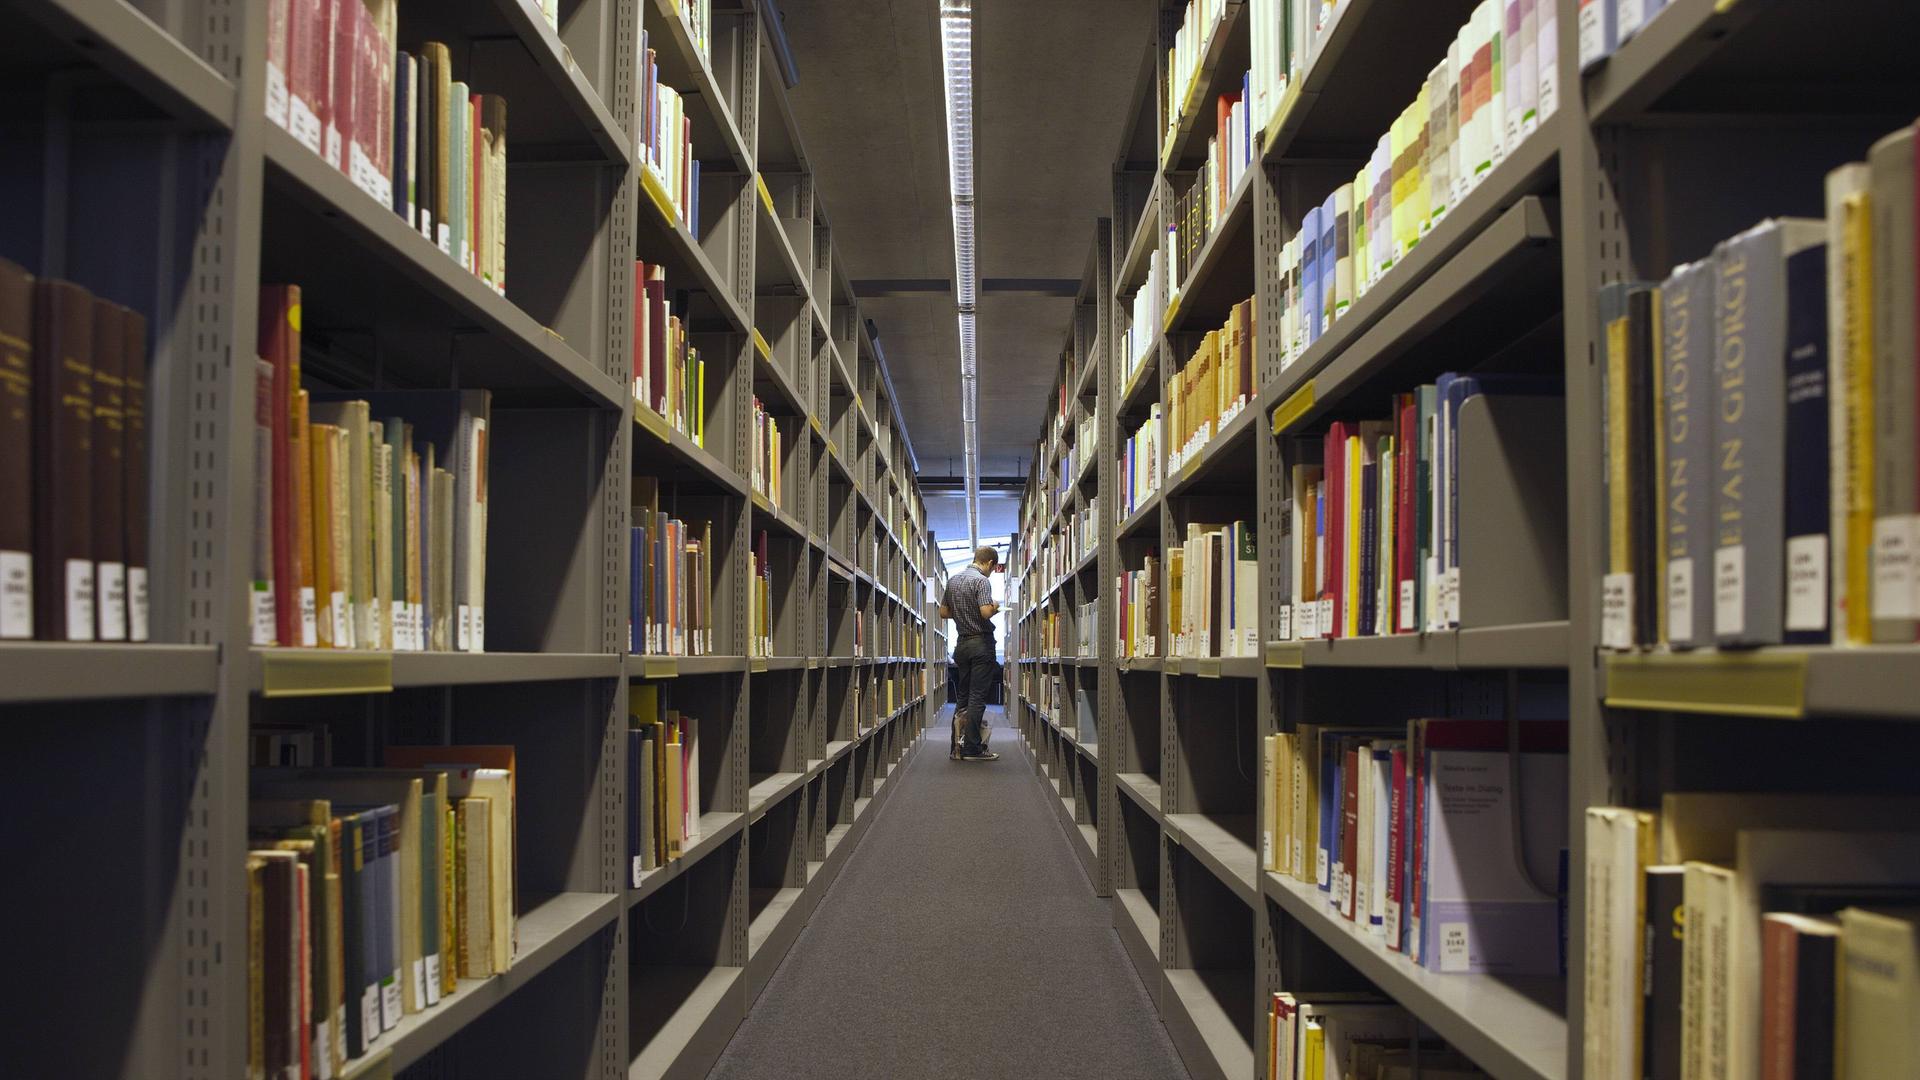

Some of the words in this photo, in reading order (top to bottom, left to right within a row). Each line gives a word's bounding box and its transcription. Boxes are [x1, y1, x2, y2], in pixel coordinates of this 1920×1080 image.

[1670, 287, 1690, 444] GEORGE
[1721, 253, 1748, 424] GEORGE
[1669, 457, 1689, 558] EFAN
[1720, 439, 1745, 546] EFAN
[1478, 783, 1504, 795] Dialog
